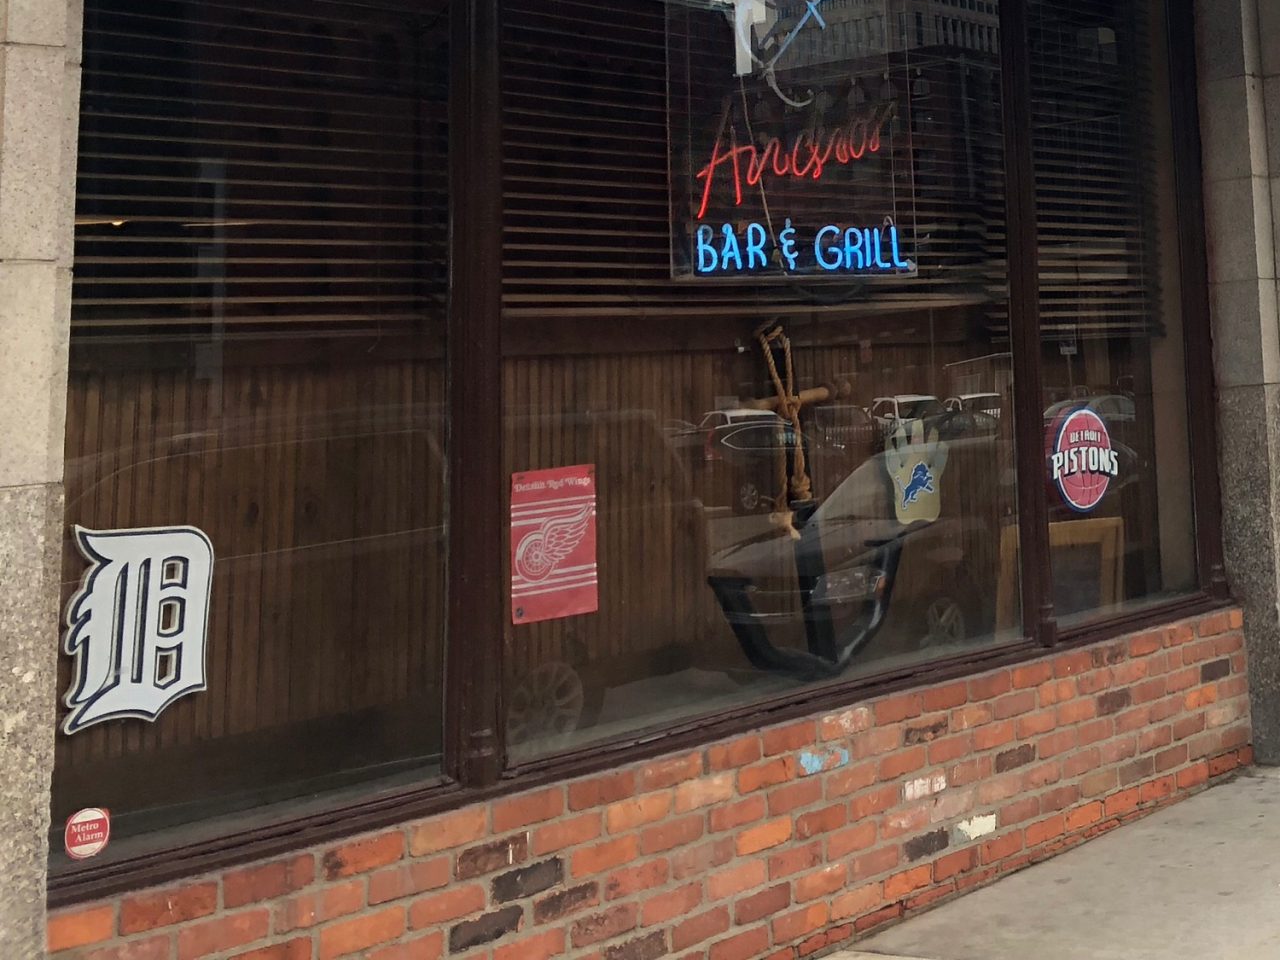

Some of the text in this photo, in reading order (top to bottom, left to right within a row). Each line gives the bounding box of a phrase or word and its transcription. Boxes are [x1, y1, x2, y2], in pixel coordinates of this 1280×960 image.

[696, 223, 766, 273] BAR
[814, 216, 908, 270] GRILL
[1069, 430, 1101, 443] DETROIT
[1052, 446, 1119, 480] PISTONS
[71, 822, 99, 834] Metro
[75, 831, 103, 843] Alarm
